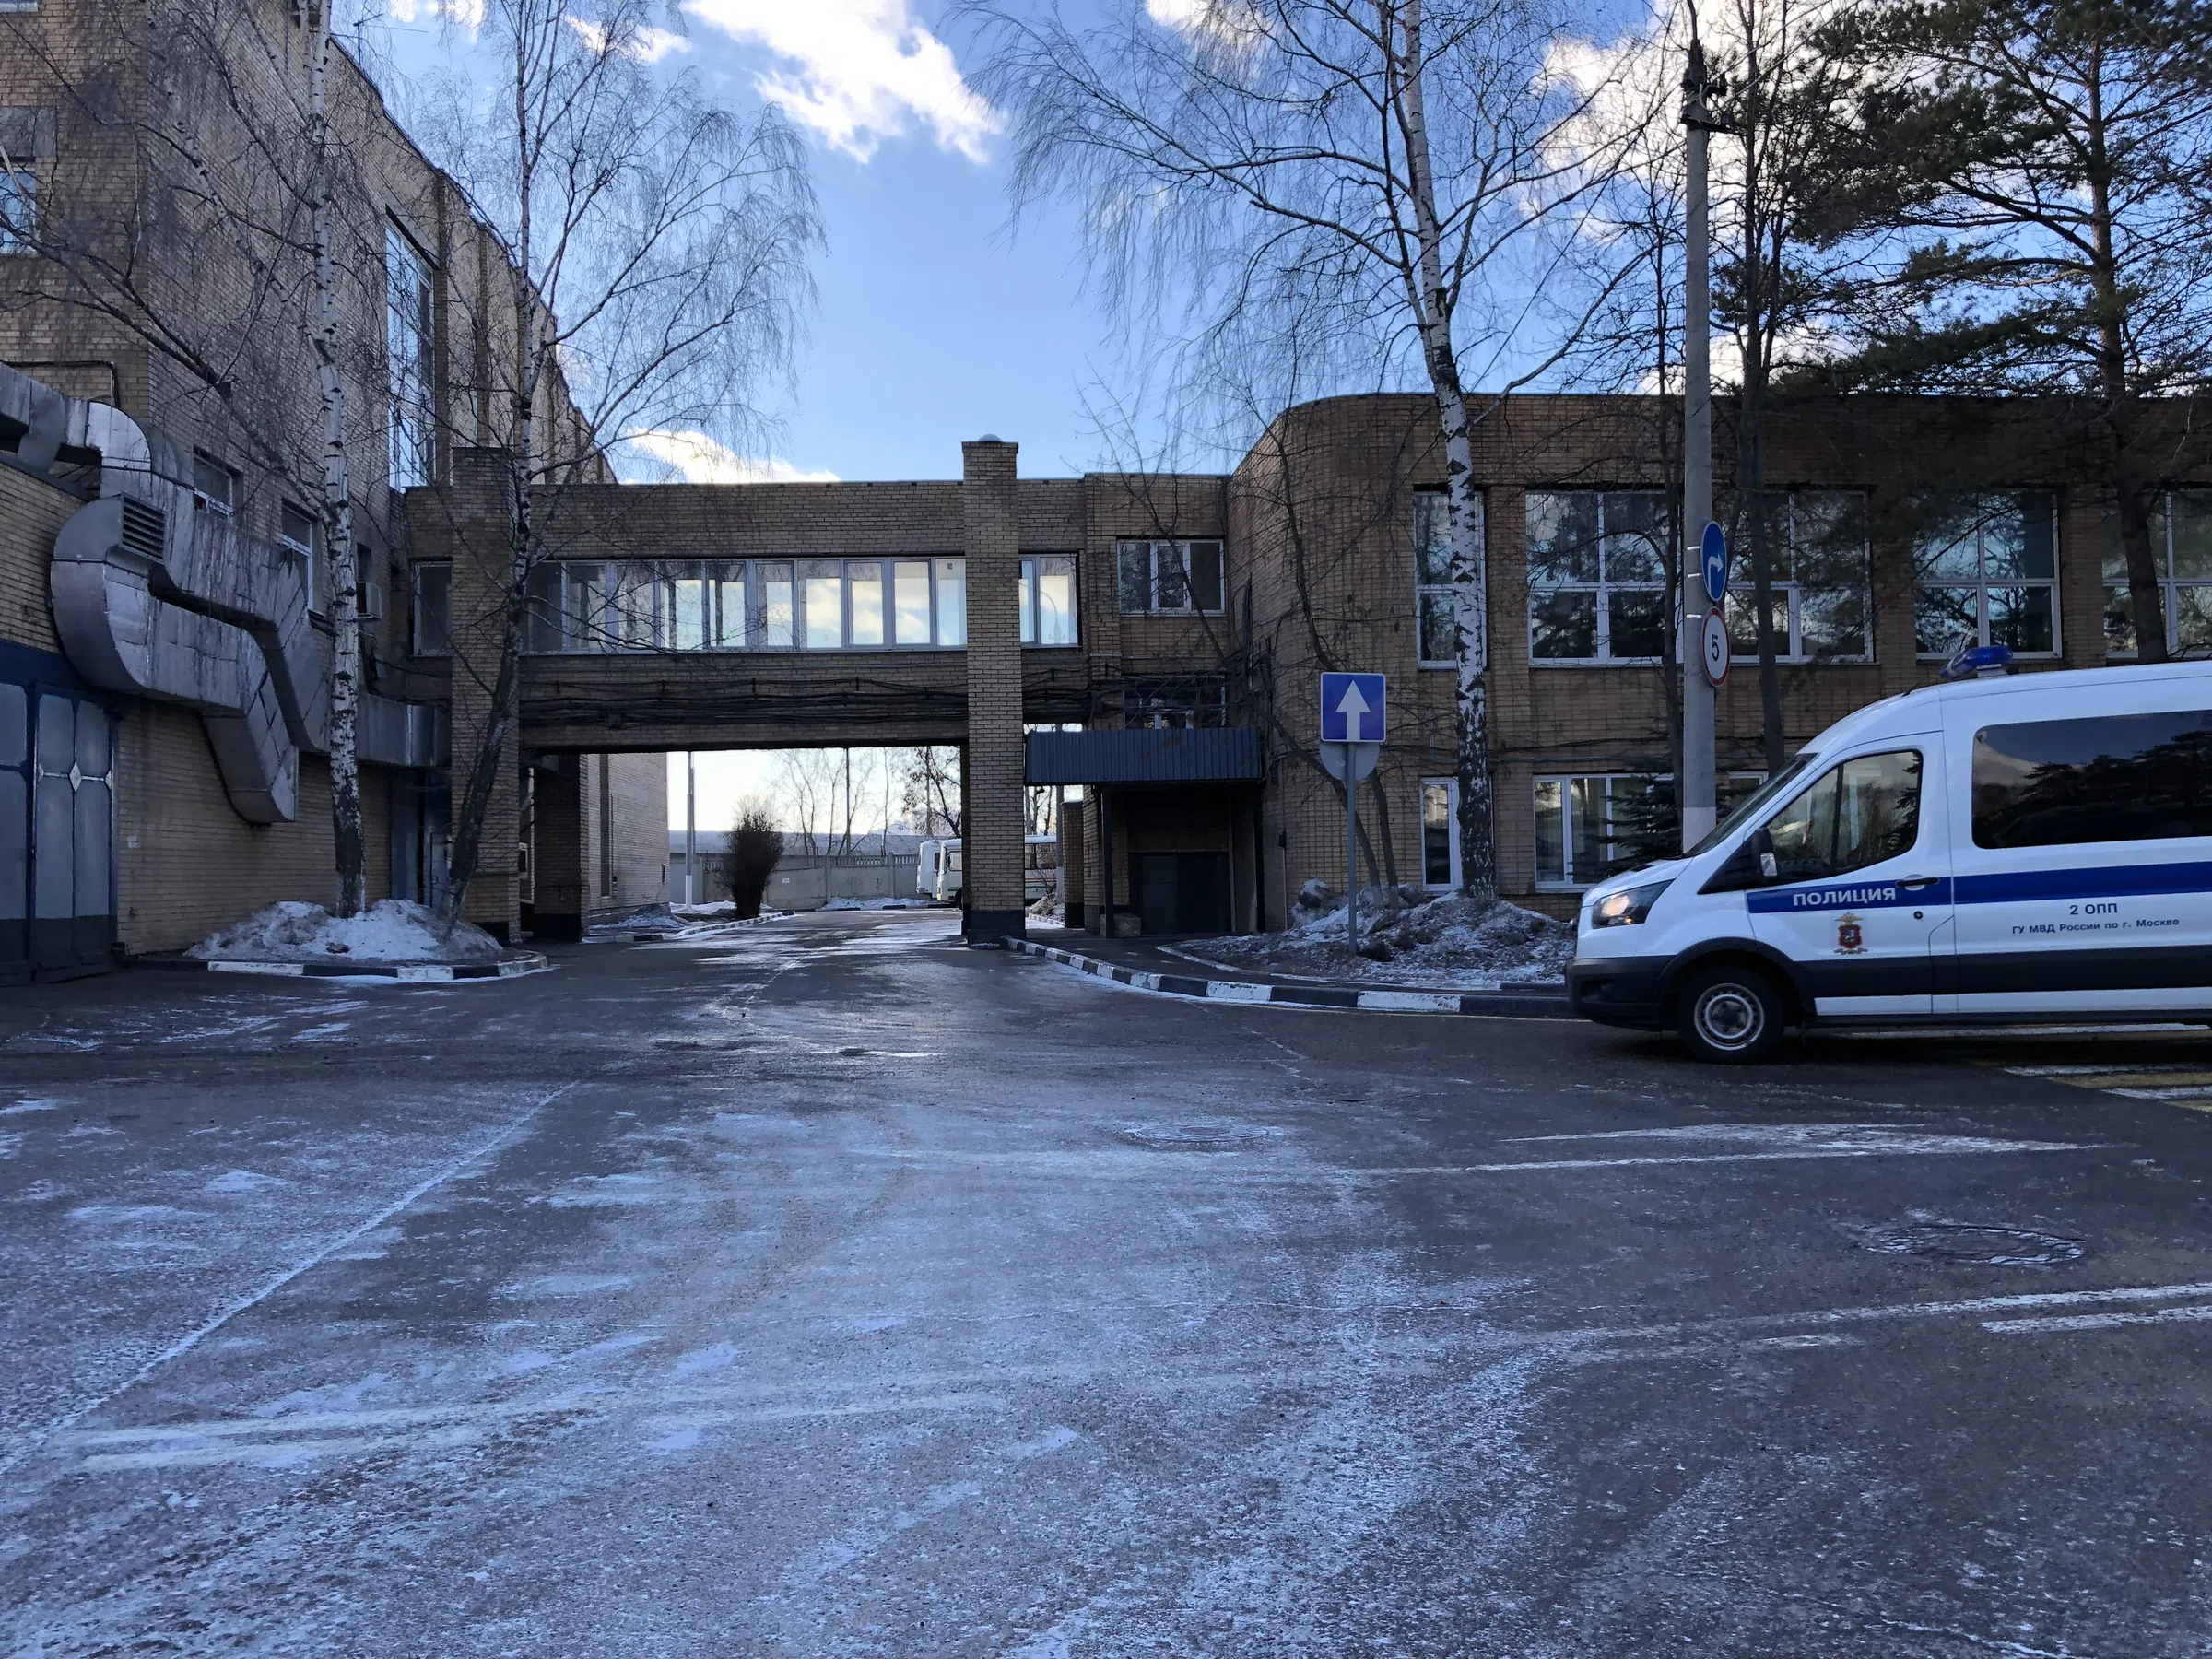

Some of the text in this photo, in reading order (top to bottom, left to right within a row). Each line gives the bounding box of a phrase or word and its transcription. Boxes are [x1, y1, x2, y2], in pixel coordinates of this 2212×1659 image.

[1712, 633, 1719, 661] 5
[1793, 888, 1897, 906] ПОЛИЦИЯ
[2069, 903, 2118, 915] 2 ОПП
[2012, 925, 2025, 934] ГУ
[2029, 924, 2055, 934] МВД
[2059, 923, 2100, 932] России
[2136, 919, 2180, 927] Москве
